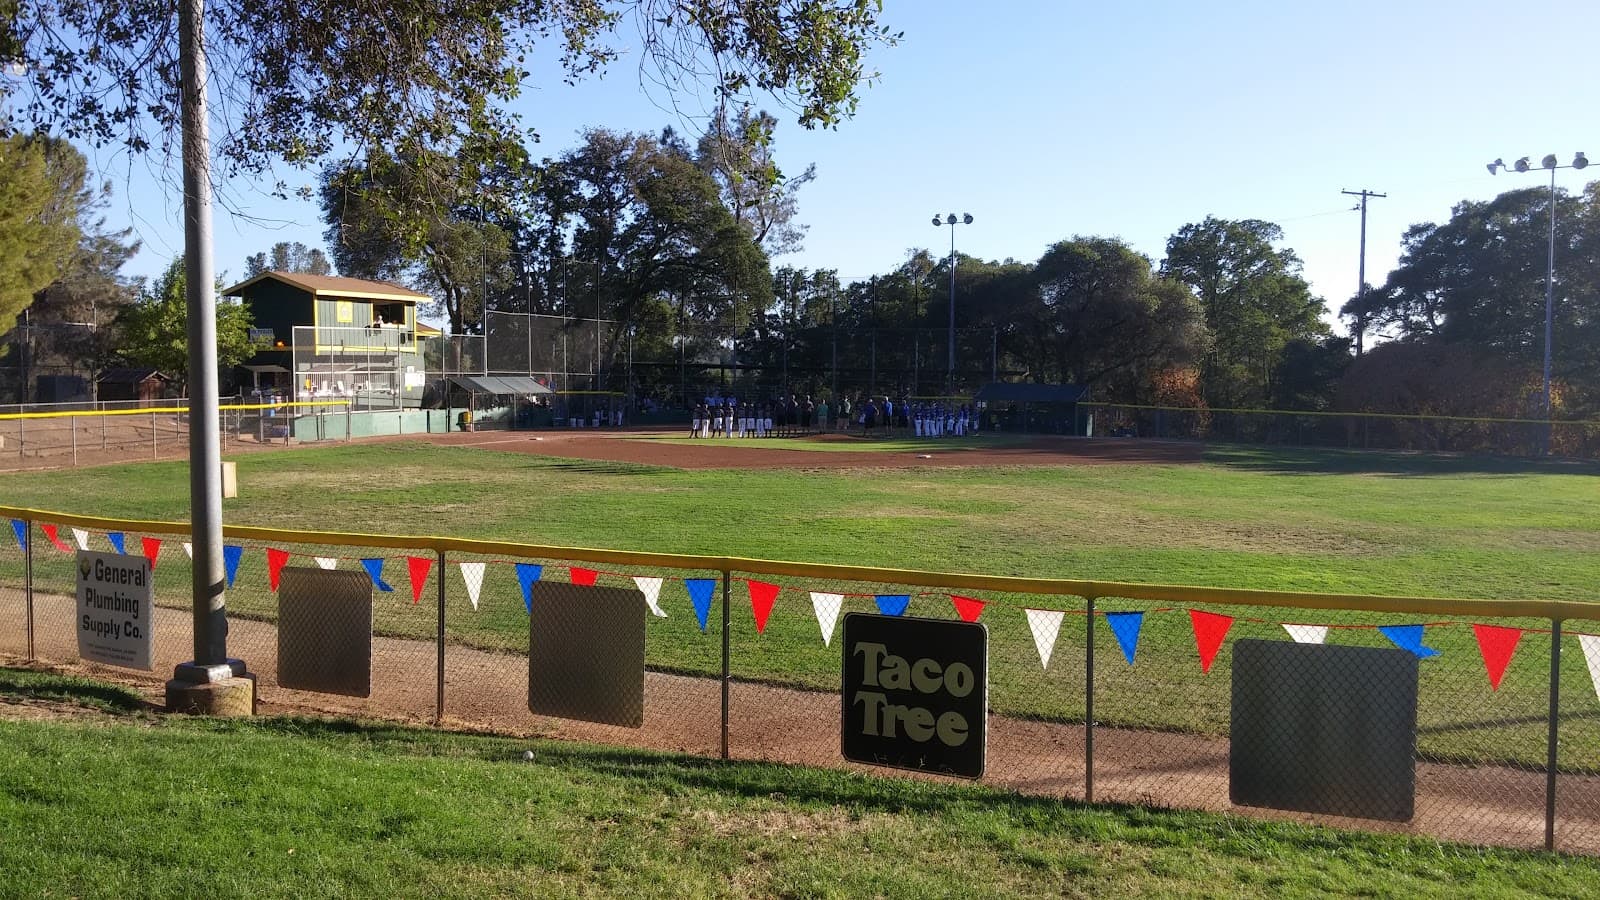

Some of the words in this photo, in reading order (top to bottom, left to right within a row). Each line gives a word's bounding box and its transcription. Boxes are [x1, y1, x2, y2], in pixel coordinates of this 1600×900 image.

[95, 559, 146, 587] General
[85, 588, 139, 619] Plumbing
[82, 615, 120, 640] Supply
[123, 621, 143, 639] Co.
[853, 642, 975, 698] Taco
[853, 691, 969, 747] Tree
